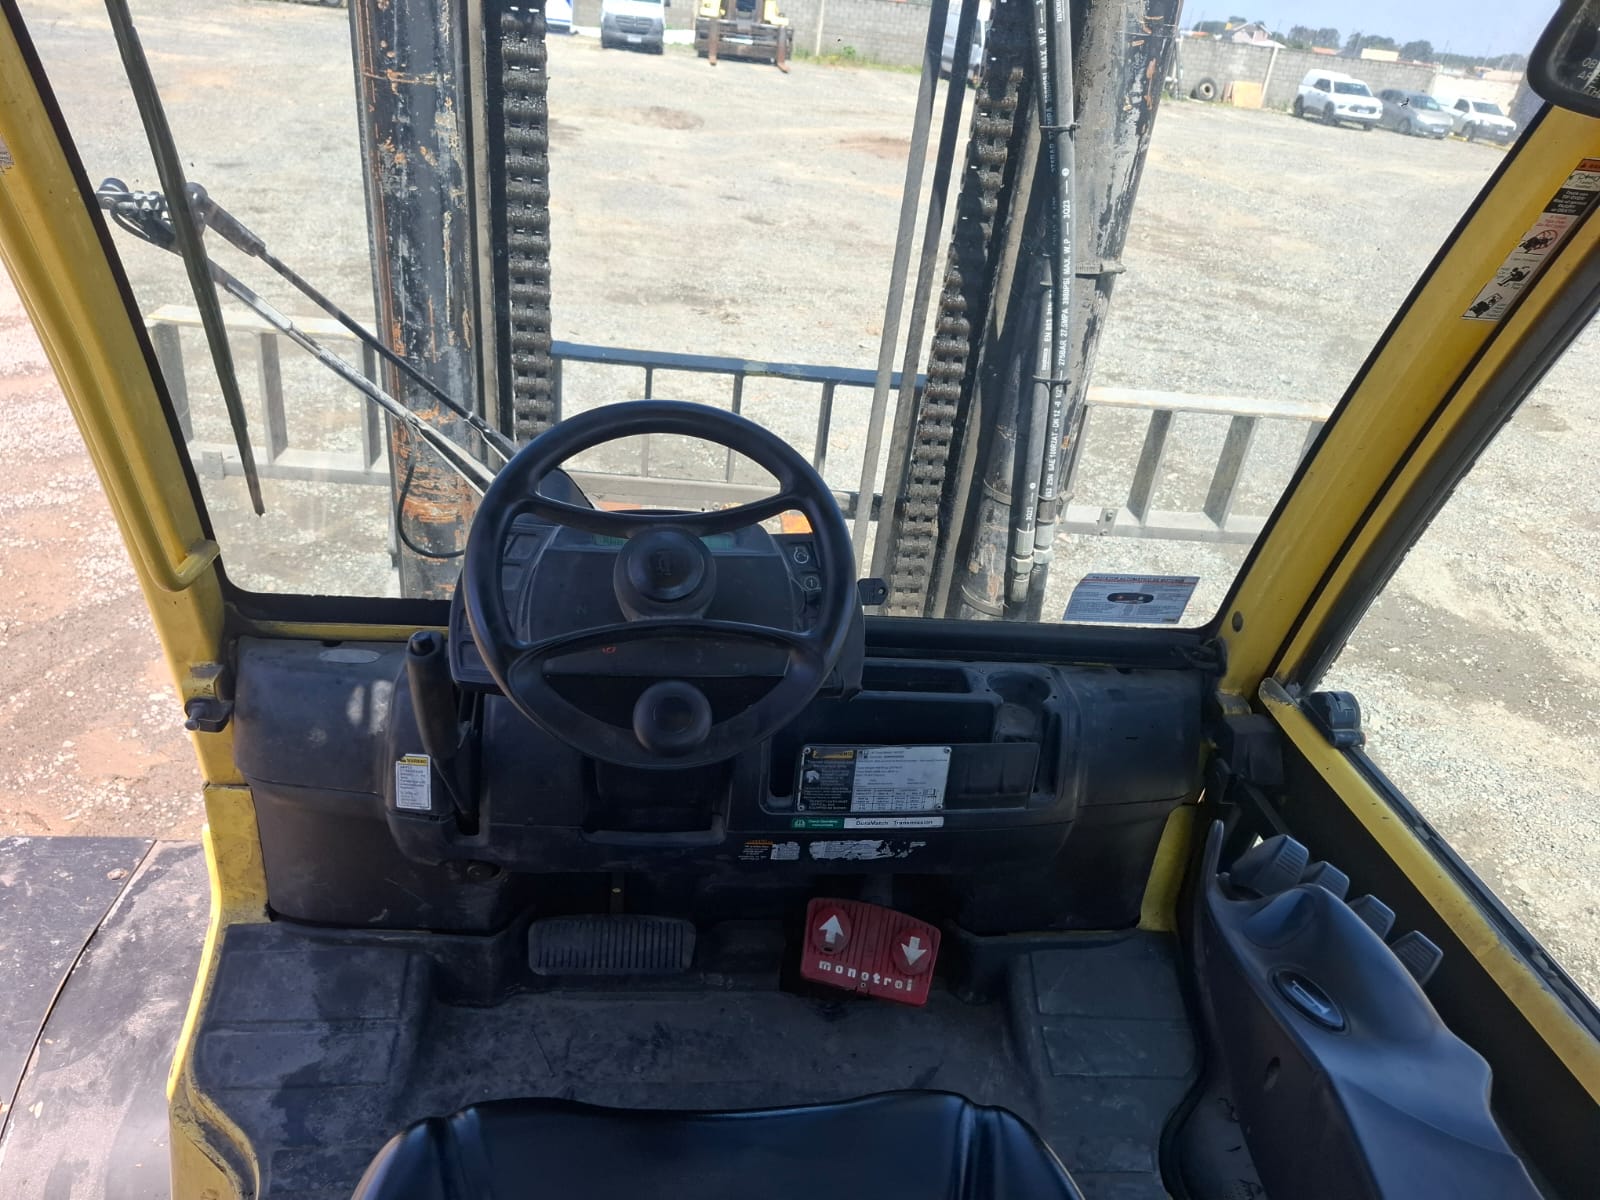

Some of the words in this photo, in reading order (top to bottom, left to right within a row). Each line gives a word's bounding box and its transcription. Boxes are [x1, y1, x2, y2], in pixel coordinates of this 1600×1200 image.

[1063, 255, 1071, 275] MAX.
[1060, 308, 1069, 338] 27.5MPA
[1058, 339, 1067, 366] 275BAR
[1048, 458, 1056, 472] SAE
[818, 960, 913, 992] monotrol
